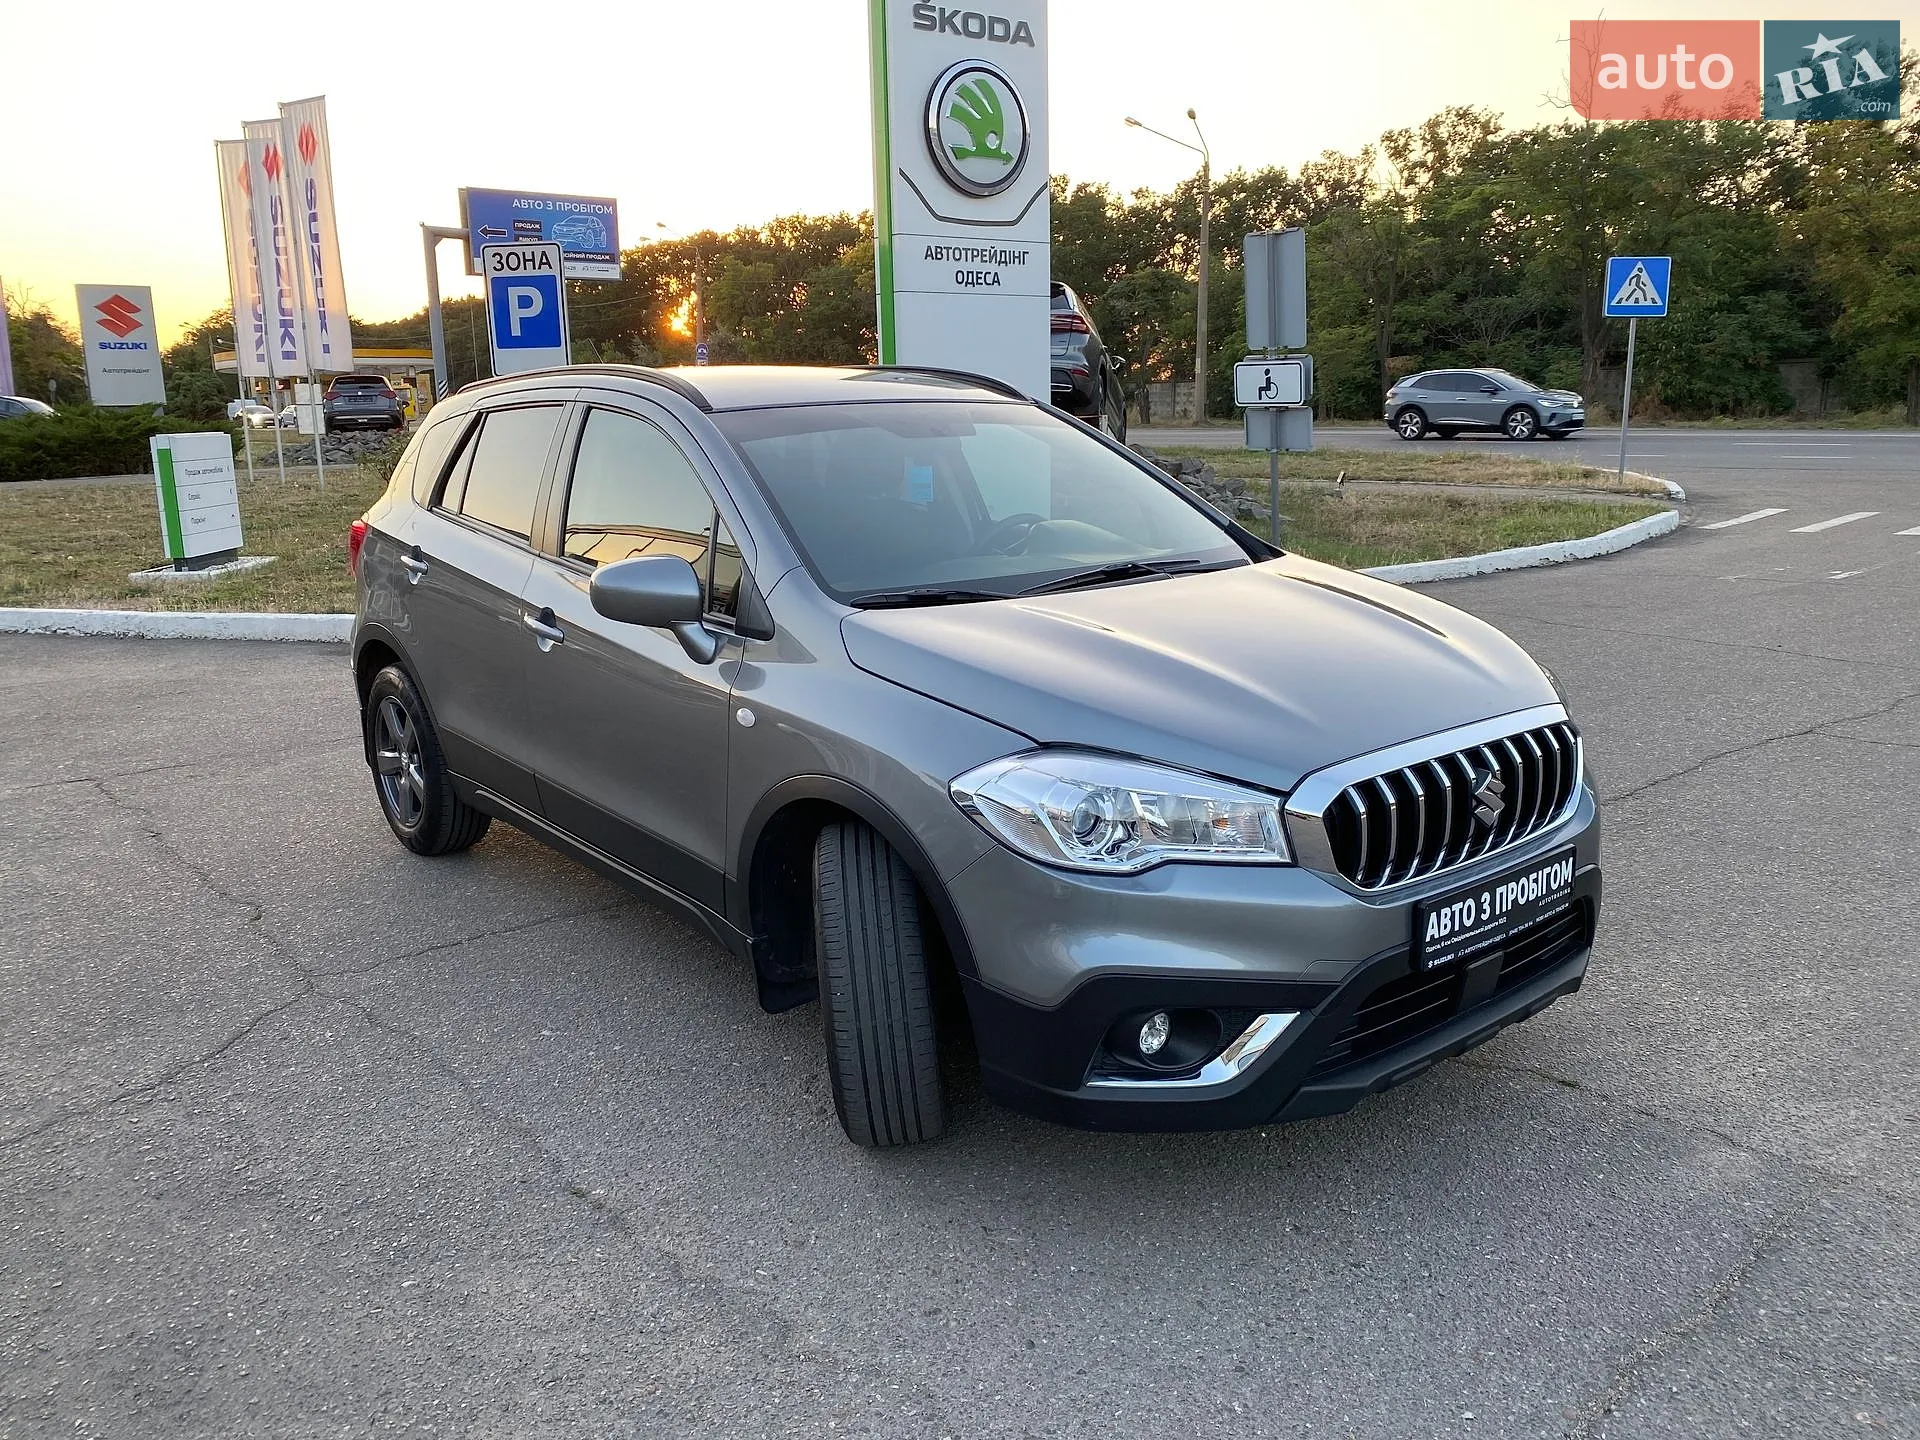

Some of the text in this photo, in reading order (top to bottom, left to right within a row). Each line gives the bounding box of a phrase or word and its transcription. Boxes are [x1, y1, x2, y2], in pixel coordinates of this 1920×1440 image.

[912, 0, 1035, 48] ŠKODA
[512, 198, 614, 215] АВТО З ПРОБІГОМ
[514, 221, 541, 230] ПРОДАЖ
[491, 250, 553, 272] ЗОНА
[586, 253, 611, 261] ПРОДАЖ
[924, 245, 1030, 267] АВТОТРЕЙДІНГ
[270, 194, 297, 362] SUZUKI
[955, 270, 1001, 288] ОДЕСА
[507, 286, 544, 337] P
[98, 342, 148, 350] SUZUKI
[1425, 856, 1574, 942] АВТО З ПРОБІГОМ
[1538, 887, 1571, 907] AUTOTRADING
